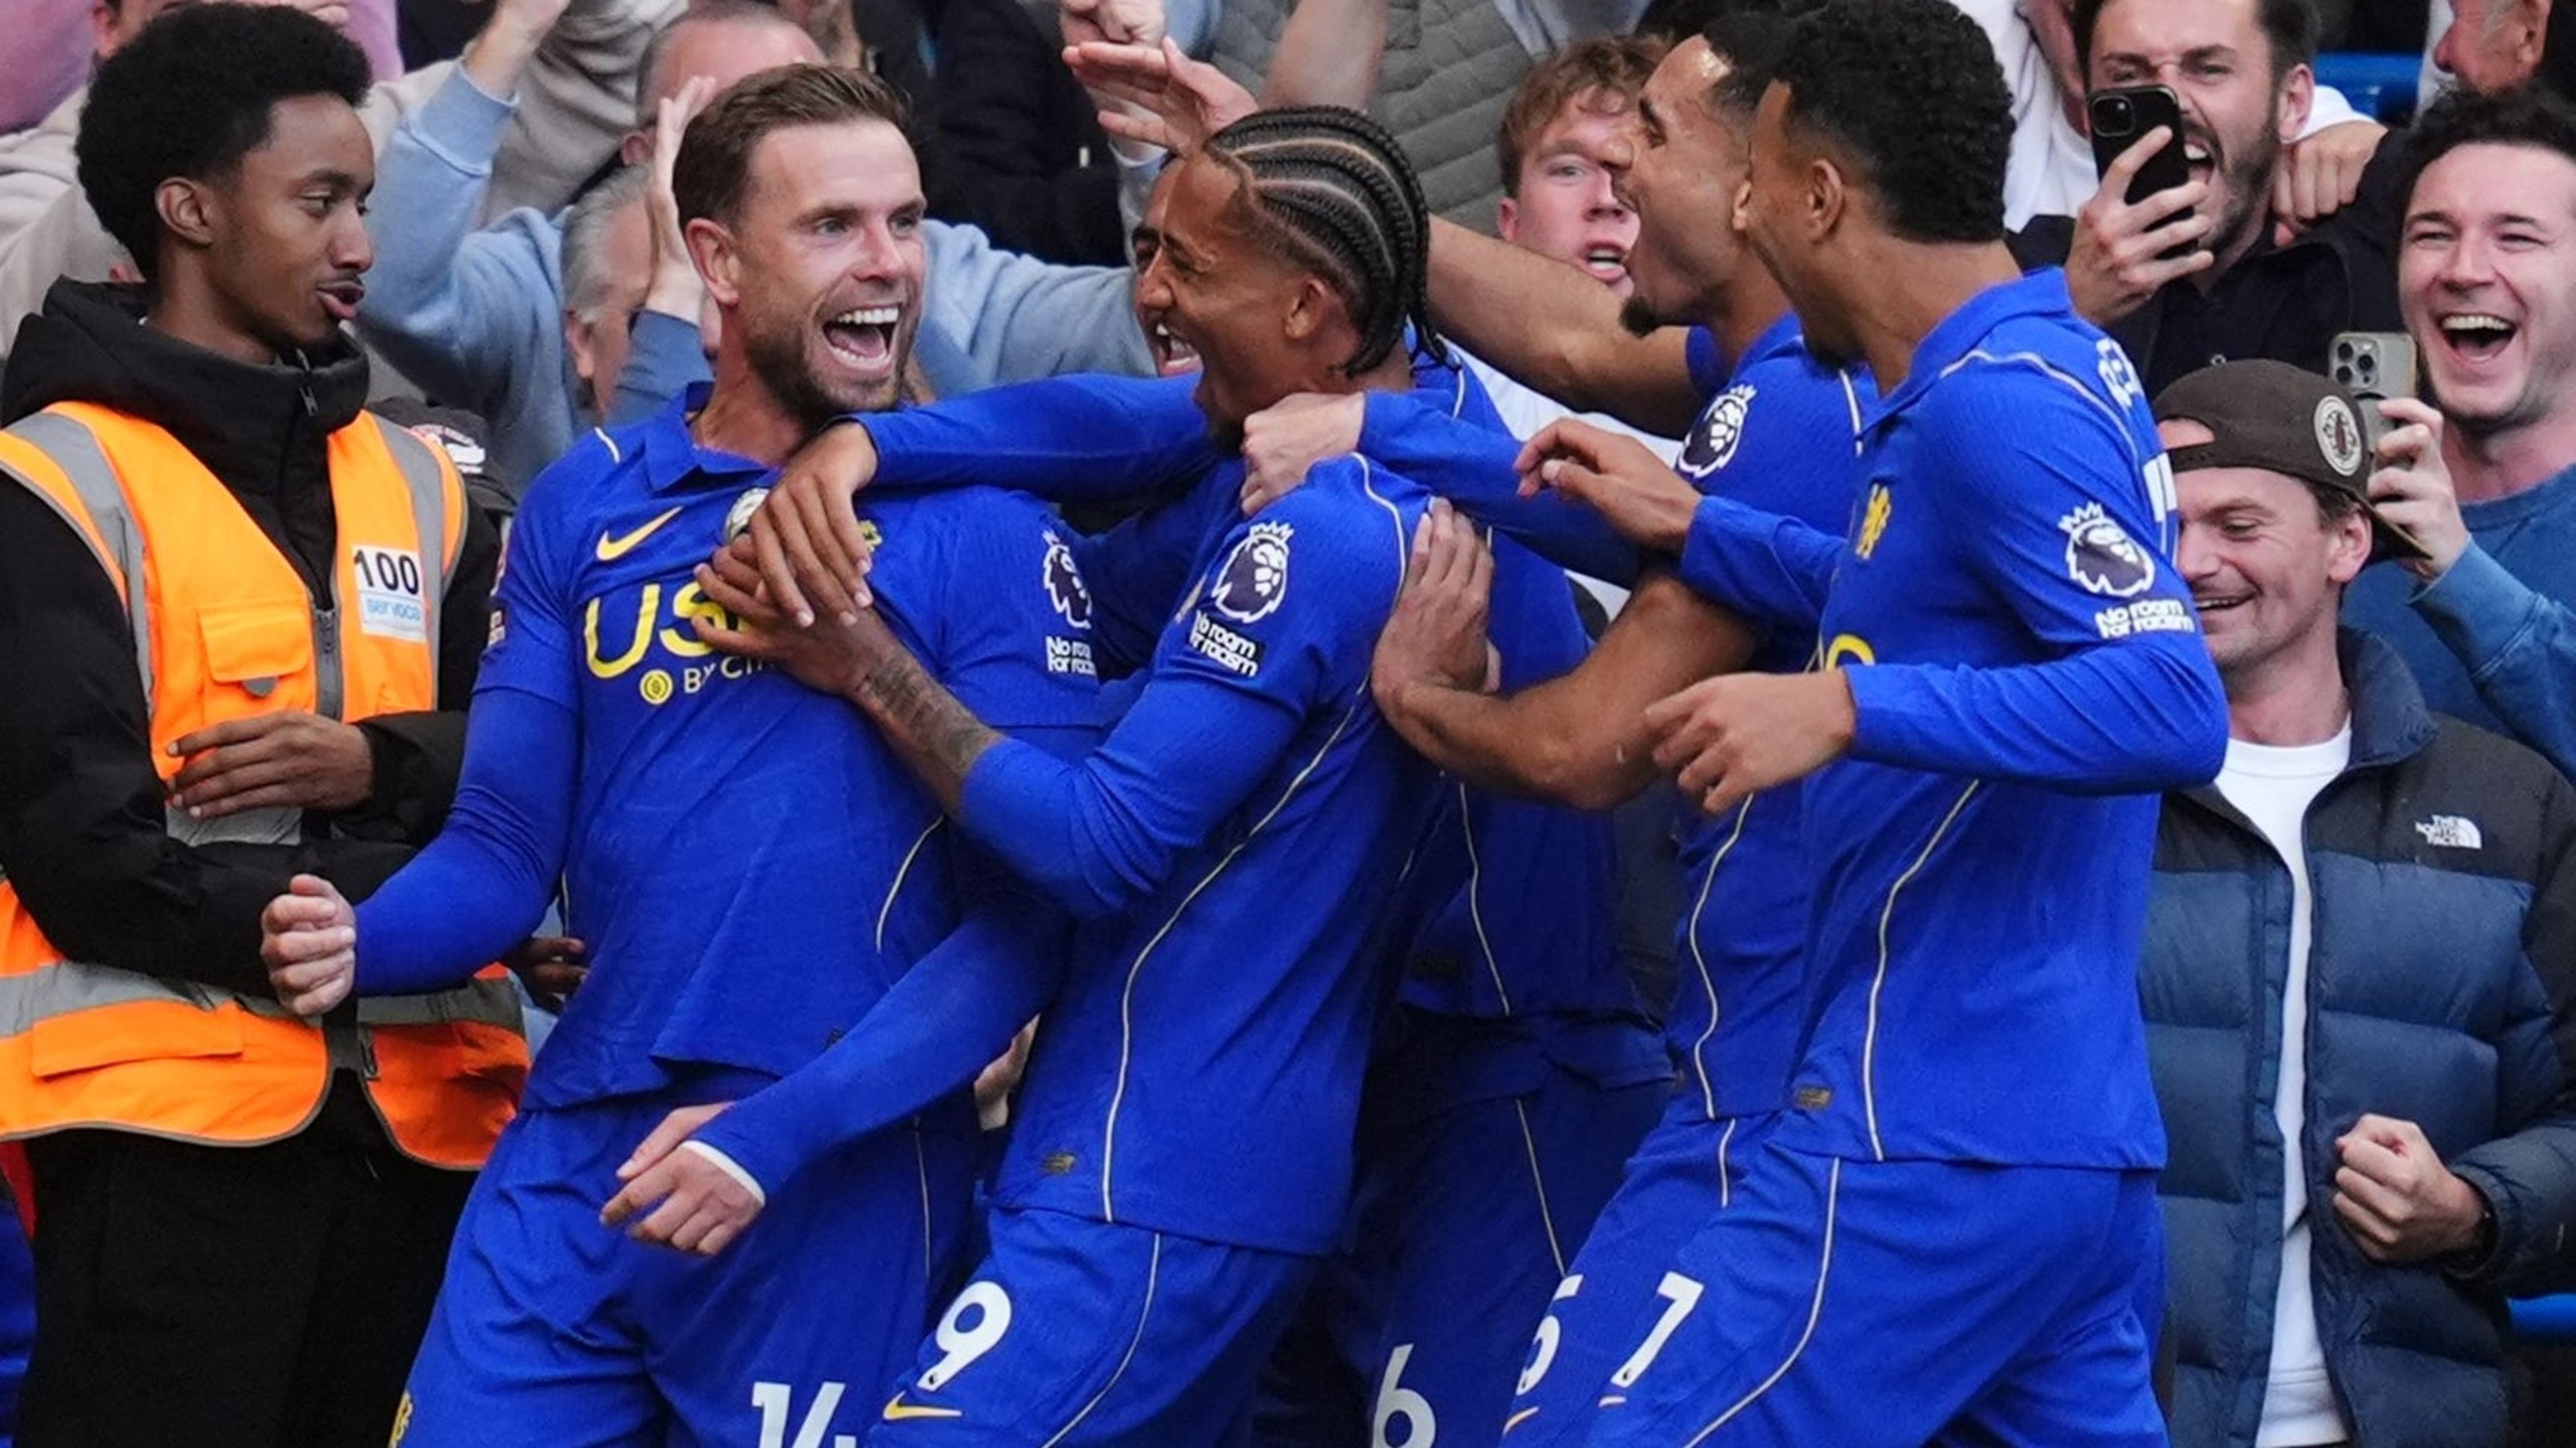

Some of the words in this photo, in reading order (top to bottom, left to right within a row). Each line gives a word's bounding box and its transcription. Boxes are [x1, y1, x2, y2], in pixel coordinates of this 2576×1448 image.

[354, 549, 419, 596] 100
[2095, 607, 2129, 626] No
[2129, 599, 2184, 618] room
[1046, 635, 1071, 656] No
[1199, 638, 1258, 678] racism
[1209, 623, 1256, 659] room
[916, 1280, 1012, 1392] 9
[1611, 1271, 1705, 1388] 7
[752, 1381, 857, 1448] 14
[1373, 1343, 1437, 1448] 6
